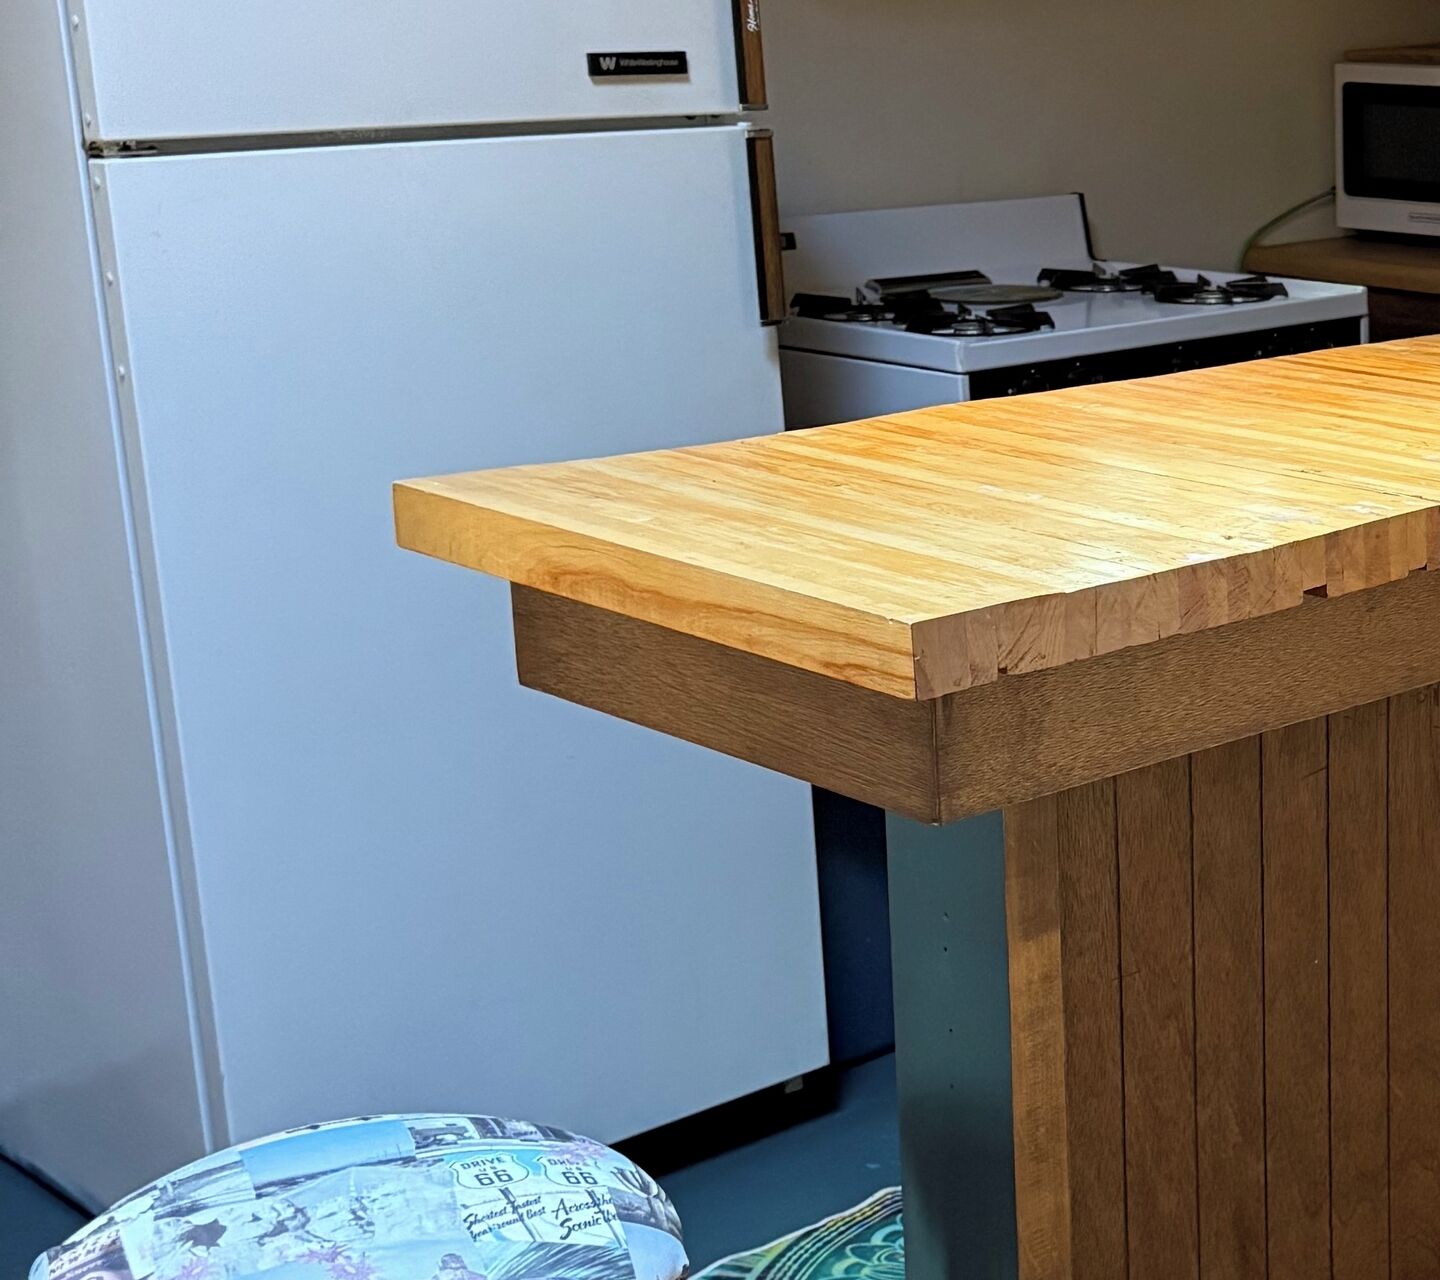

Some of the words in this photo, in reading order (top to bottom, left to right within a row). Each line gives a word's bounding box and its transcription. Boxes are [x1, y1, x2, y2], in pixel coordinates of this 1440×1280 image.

[460, 1156, 506, 1170] DRIVE
[474, 1169, 514, 1187] 66
[561, 1171, 598, 1185] 66
